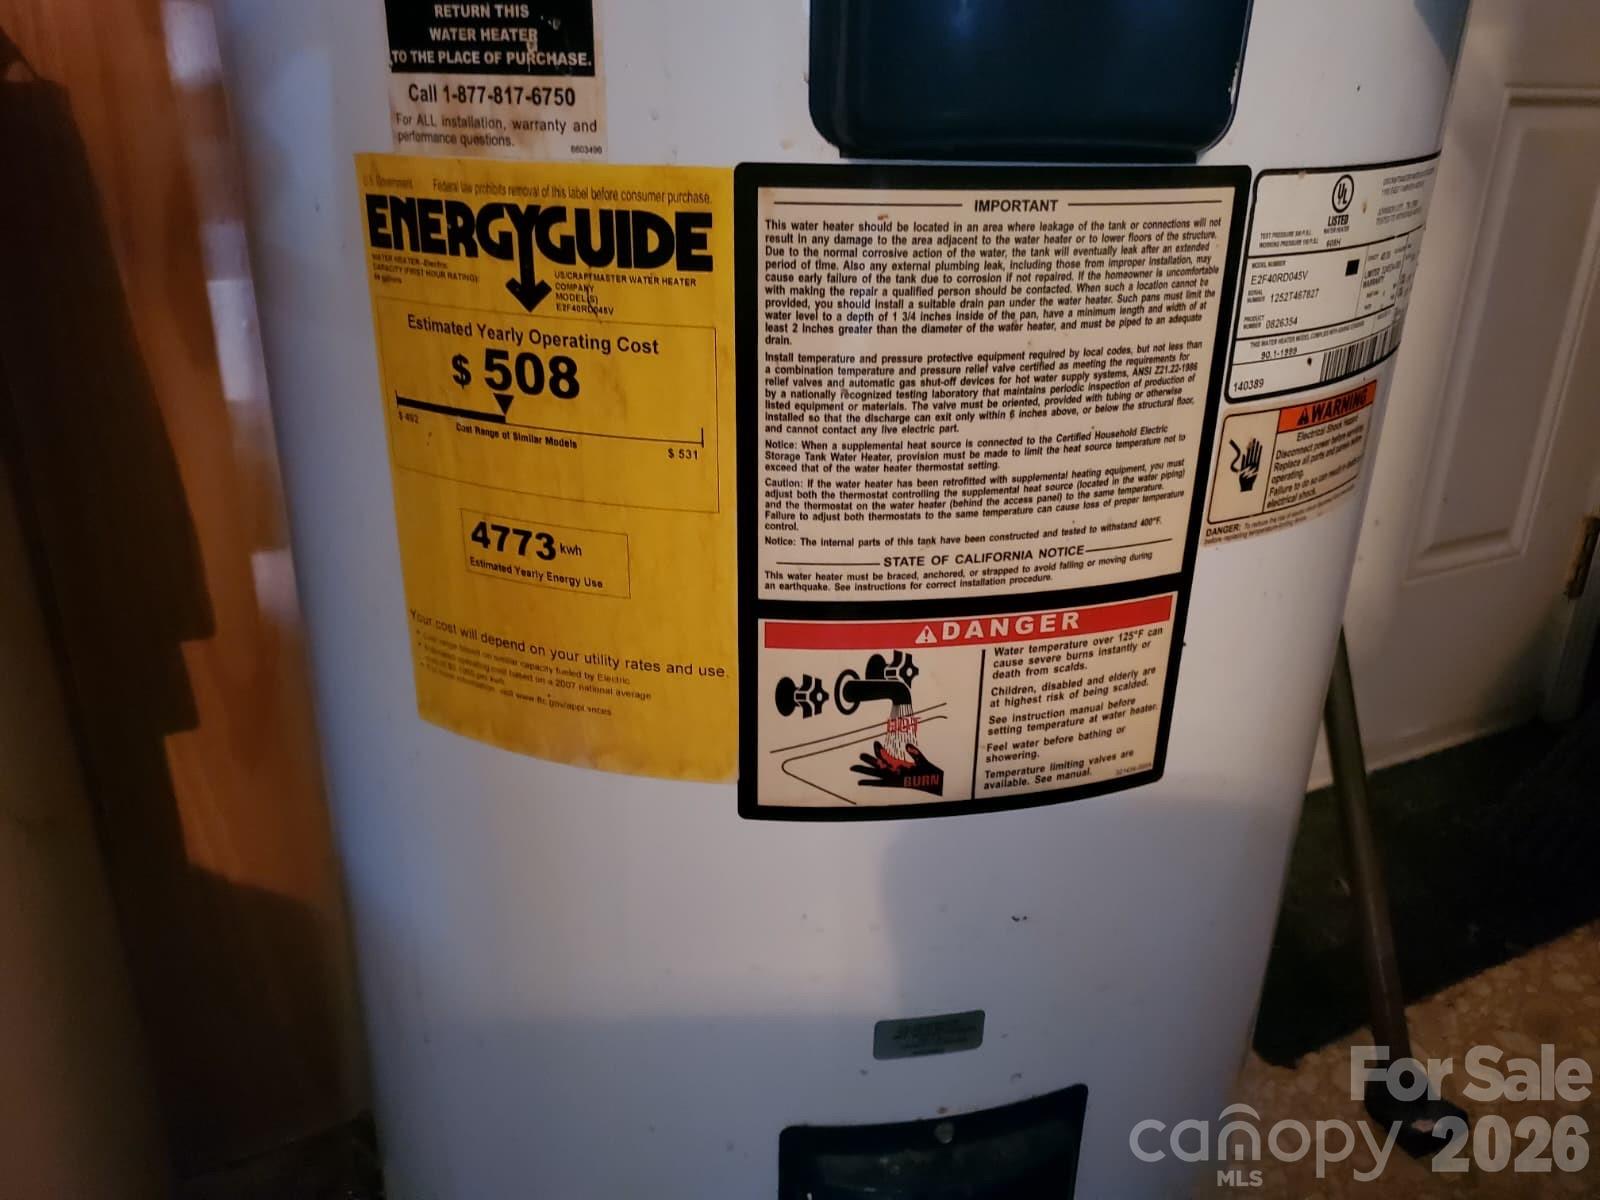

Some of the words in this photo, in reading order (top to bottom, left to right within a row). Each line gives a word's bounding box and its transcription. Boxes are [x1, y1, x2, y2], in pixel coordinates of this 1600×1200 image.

[434, 4, 490, 18] RETURN
[495, 5, 529, 17] THIS
[429, 28, 476, 41] WATER
[481, 29, 538, 41] HEATER
[391, 50, 407, 62] TO
[410, 51, 434, 64] THE
[438, 51, 479, 64] PLACE
[484, 52, 500, 64] OF
[507, 52, 591, 66] PURCHASE.
[409, 84, 437, 102] Call
[443, 86, 575, 106] 1-877-817-6750
[396, 114, 412, 125] For
[417, 114, 436, 127] ALL
[442, 115, 506, 130] installation,
[512, 119, 566, 134] warranty
[573, 120, 597, 132] and
[398, 131, 456, 144] performance
[460, 134, 514, 147] questions.
[433, 178, 458, 192] Federal
[460, 181, 472, 194] law
[474, 182, 505, 197] prohibits
[508, 183, 539, 197] removal
[541, 185, 549, 197] of
[551, 186, 566, 198] this
[568, 186, 588, 200] label
[591, 187, 618, 201] before
[621, 191, 665, 203] consumer
[667, 191, 712, 206] purchase.
[974, 200, 1058, 212] IMPORTANT
[765, 220, 786, 231] This
[791, 221, 818, 231] water
[823, 221, 854, 232] heater
[859, 222, 892, 232] should
[897, 222, 909, 232] be
[913, 222, 949, 232] located
[954, 222, 962, 232] in
[967, 224, 978, 232] an
[983, 223, 1003, 232] area
[1008, 222, 1035, 231] where
[1039, 222, 1074, 234] leakage
[1078, 221, 1086, 231] of
[1091, 221, 1104, 231] the
[1108, 220, 1126, 230] tank
[1130, 222, 1138, 230] or
[1143, 219, 1190, 230] connections
[1194, 218, 1206, 228] will
[1209, 218, 1221, 227] not
[1327, 215, 1349, 227] LISTED
[365, 194, 713, 272] ENERGYGUIDE
[555, 282, 594, 292] COMPANY
[630, 275, 659, 286] WATER
[661, 277, 696, 287] HEATER
[1251, 271, 1308, 285] E2F40RD045V
[1266, 317, 1298, 329] 0826354
[408, 314, 472, 336] Estimated
[477, 324, 523, 346] Yearly
[529, 329, 611, 354] Operating
[617, 337, 659, 354] Cost
[452, 354, 471, 389] $
[484, 348, 579, 399] 508
[1234, 378, 1264, 392] 140389
[1311, 388, 1368, 423] WARNING
[456, 424, 472, 433] Cost
[475, 426, 500, 441] Range
[512, 433, 542, 445] Similar
[545, 437, 577, 449] Models
[668, 449, 674, 460] $
[679, 449, 698, 460] 531
[1276, 444, 1313, 459] Disconnect
[1273, 459, 1299, 471] Replace
[1269, 483, 1292, 497] Failure
[1267, 495, 1298, 508] electrical
[1206, 524, 1241, 537] DANGER:
[471, 521, 556, 561] 4773
[560, 543, 582, 556] kwh
[884, 557, 925, 567] STATE
[931, 555, 949, 566] OF
[955, 552, 1033, 565] CALIFORNIA
[1038, 545, 1085, 559] NOTICE
[470, 556, 512, 574] Estimated
[514, 566, 544, 581] Yearly
[547, 572, 581, 588] Energy
[584, 578, 602, 589] Use
[942, 612, 1079, 641] DANGER
[410, 609, 432, 626] Your
[436, 620, 456, 634] cost
[460, 626, 478, 641] will
[481, 632, 525, 652] depend
[530, 644, 546, 656] on
[550, 649, 578, 664] your
[584, 654, 620, 671] utility
[625, 659, 661, 673] rates
[666, 662, 693, 675] and
[699, 665, 728, 677] use.
[994, 646, 1023, 656] Water
[1029, 640, 1088, 654] temperature
[1093, 636, 1114, 645] over
[1119, 629, 1144, 642] 125°F
[1147, 627, 1163, 637] can
[993, 659, 1023, 668] cause
[1028, 655, 1062, 665] severe
[1066, 649, 1093, 661] burns
[1098, 642, 1138, 656] instantly
[992, 670, 1020, 679] death
[1026, 666, 1048, 676] from
[1053, 662, 1088, 673] scalds.
[991, 684, 1037, 697] Children,
[1042, 679, 1083, 692] disabled
[1087, 674, 1105, 685] and
[1109, 669, 1138, 682] elderly
[1143, 666, 1156, 675] are
[990, 699, 1000, 707] at
[1005, 695, 1042, 708] highest
[1046, 690, 1064, 702] risk
[1069, 690, 1079, 699] of
[1083, 686, 1109, 698] being
[1113, 679, 1149, 692] scalded.
[988, 725, 1023, 736] setting
[1027, 718, 1085, 733] temperature
[1089, 715, 1098, 723] at
[1102, 710, 1126, 721] water
[1130, 704, 1158, 716] heater.
[989, 715, 1007, 724] See
[1012, 709, 1065, 721] instruction
[1070, 704, 1104, 715] manual
[1108, 698, 1135, 710] before
[987, 742, 1008, 751] Feel
[1012, 738, 1039, 749] water
[1044, 735, 1074, 746] before
[1078, 728, 1112, 741] bathing
[985, 765, 1045, 780] Temperature
[1050, 759, 1084, 772] limiting
[1089, 753, 1117, 766] valves
[1120, 750, 1134, 759] are
[986, 750, 1039, 763] showering.
[904, 774, 939, 787] BURN
[984, 776, 1029, 790] available.
[1035, 775, 1052, 784] See
[1057, 770, 1092, 782] manual.
